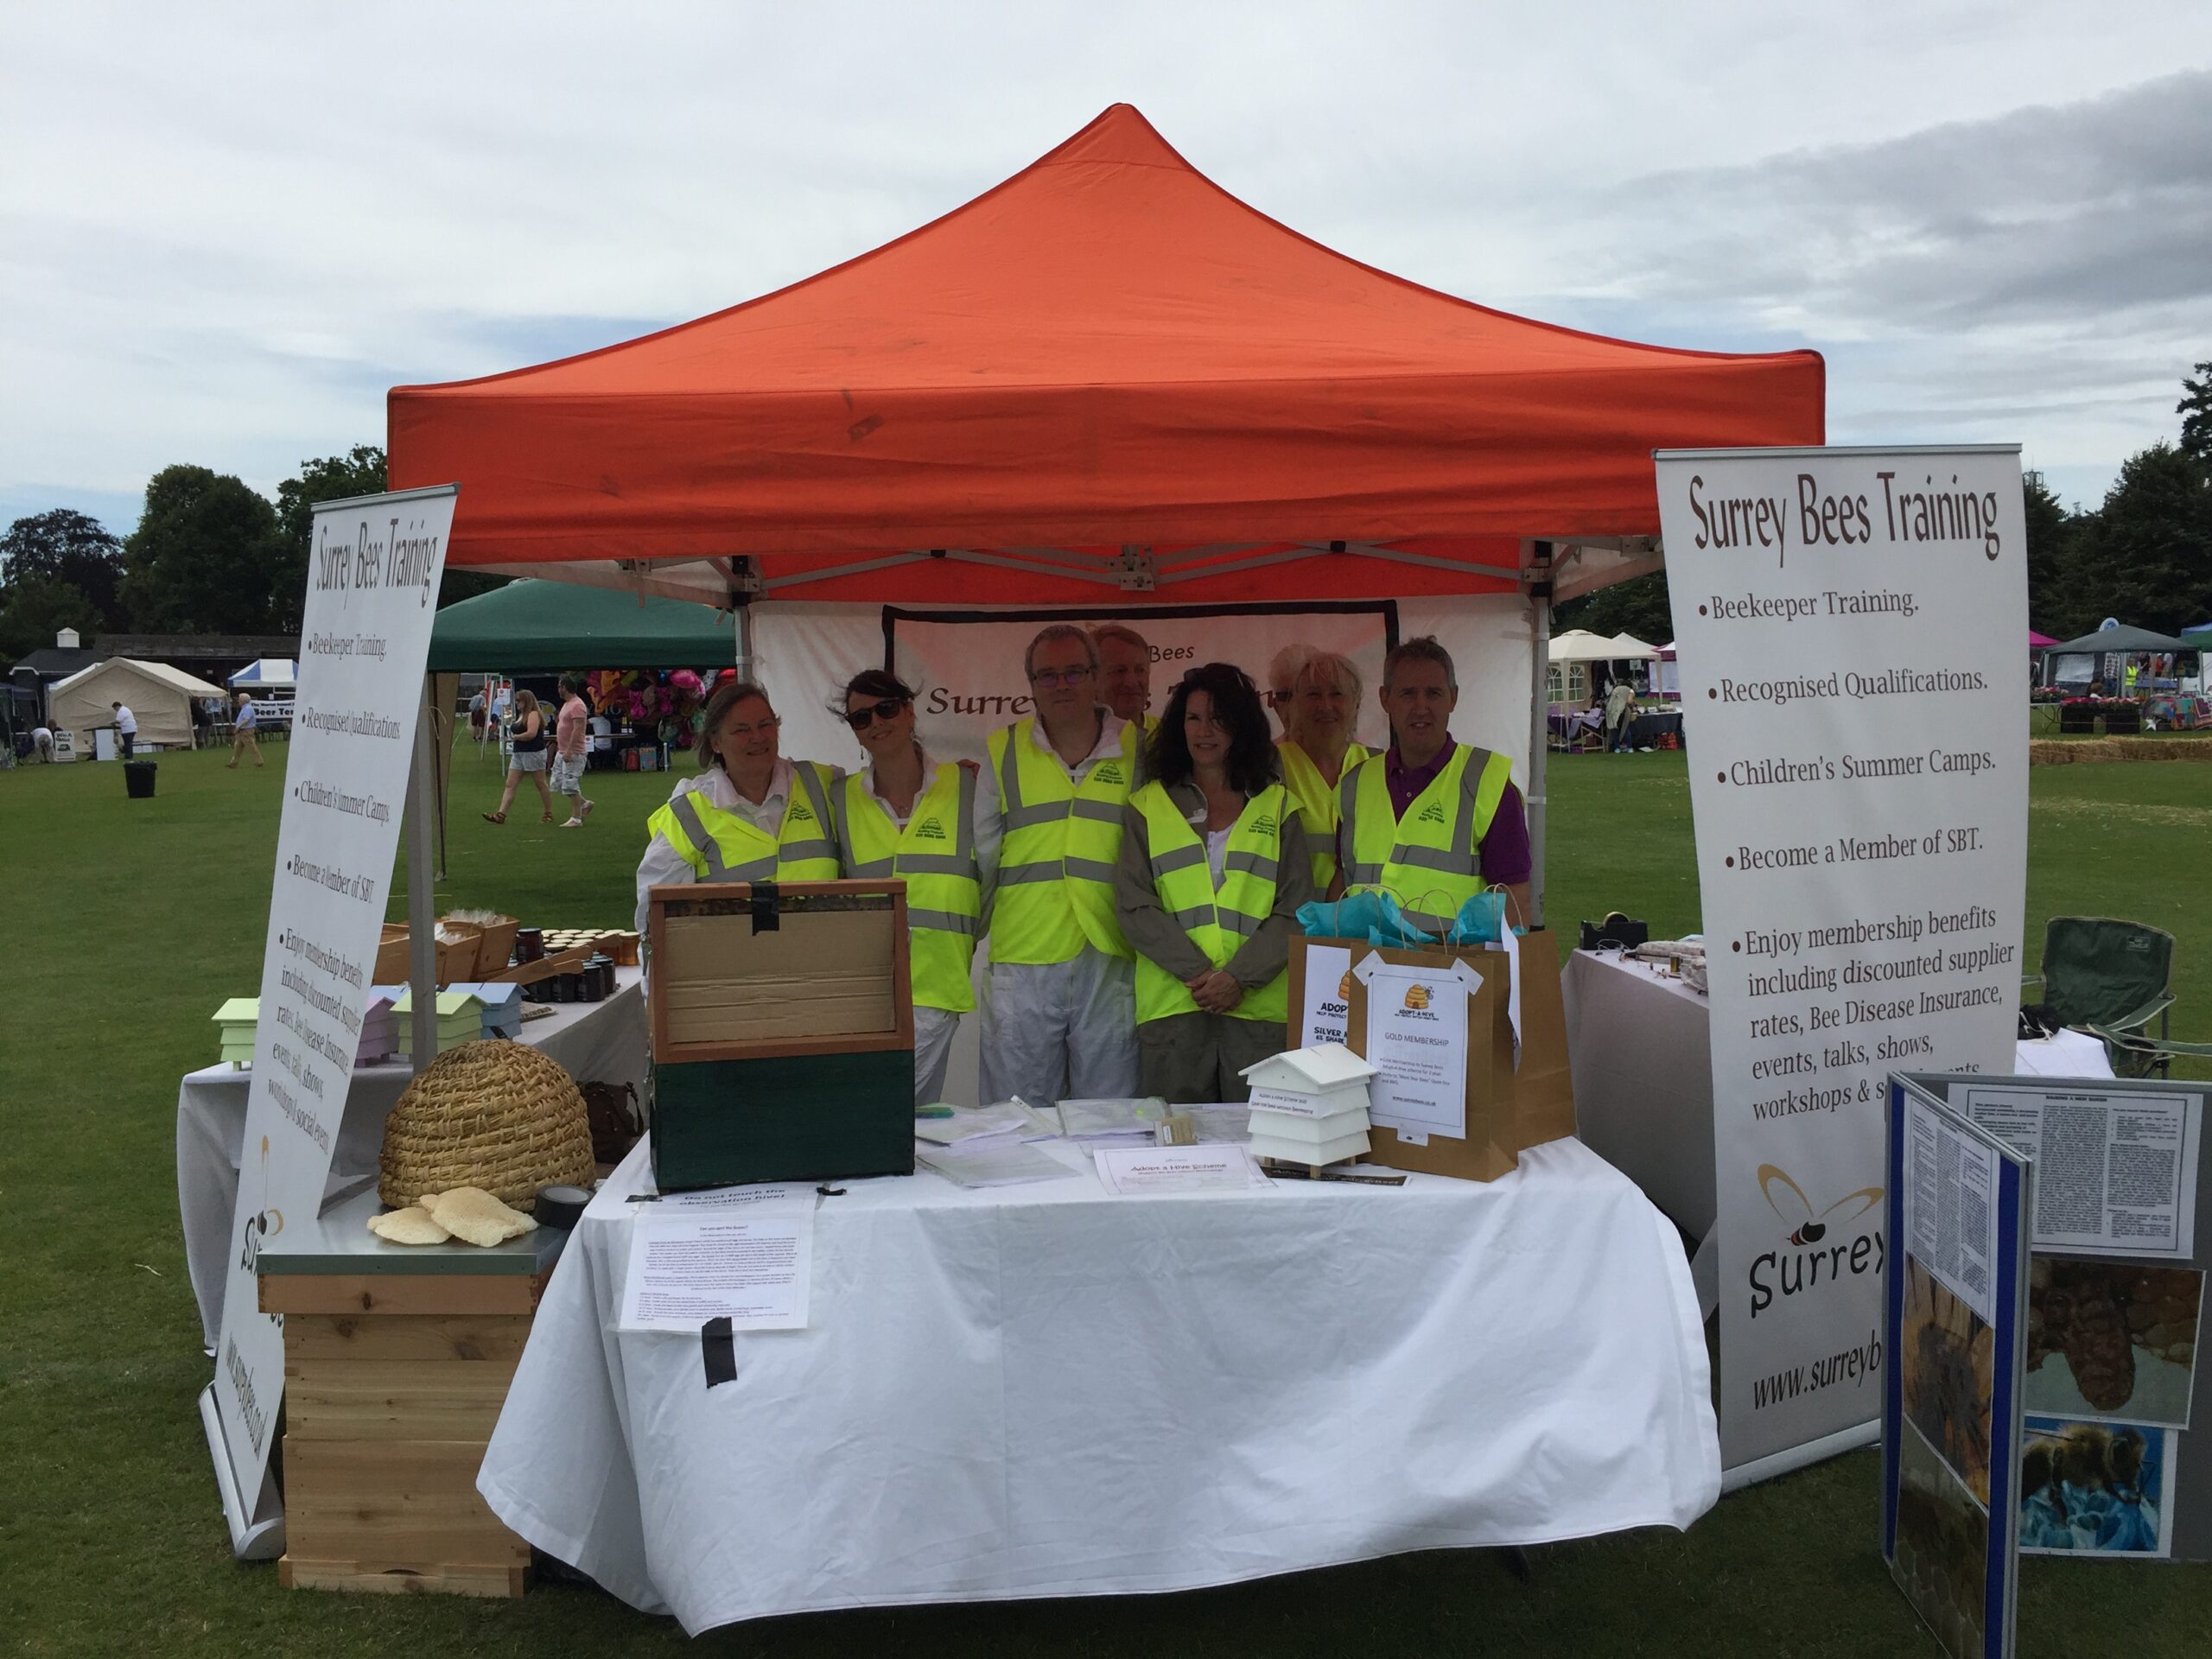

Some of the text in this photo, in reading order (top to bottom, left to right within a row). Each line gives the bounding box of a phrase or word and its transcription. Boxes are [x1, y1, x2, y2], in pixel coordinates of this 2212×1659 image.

[1689, 471, 2000, 568] Surrey Bees Training
[316, 518, 437, 610] Surrey Bees Training
[1711, 588, 1919, 621] Beekeeper Training.
[313, 632, 353, 660] Beekeeper
[1149, 645, 1195, 664] Bees
[1721, 669, 1988, 705] Recognised Qualifications.
[306, 707, 350, 735] Recognised
[1731, 748, 1996, 786] Children's Summer Camps.
[1738, 827, 1984, 870] Become a Member of SBT.
[293, 854, 321, 883] Become
[321, 868, 326, 883] a
[352, 874, 360, 897] of
[285, 928, 305, 960] Enjoy
[1745, 906, 1997, 958] Enjoy membership benefits
[1748, 942, 2015, 997] including discounted supplier
[1320, 1002, 1347, 1013] ADOP
[1750, 984, 2003, 1039] rates, Bee Disease Insurance,
[1384, 1033, 1449, 1046] GOLD MEMBERSHIP
[1752, 1034, 1934, 1079] events, talks, shows,
[1752, 1084, 1852, 1121] workshops
[1857, 1079, 1871, 1103] &
[1754, 1329, 1882, 1411] www.surreyb
